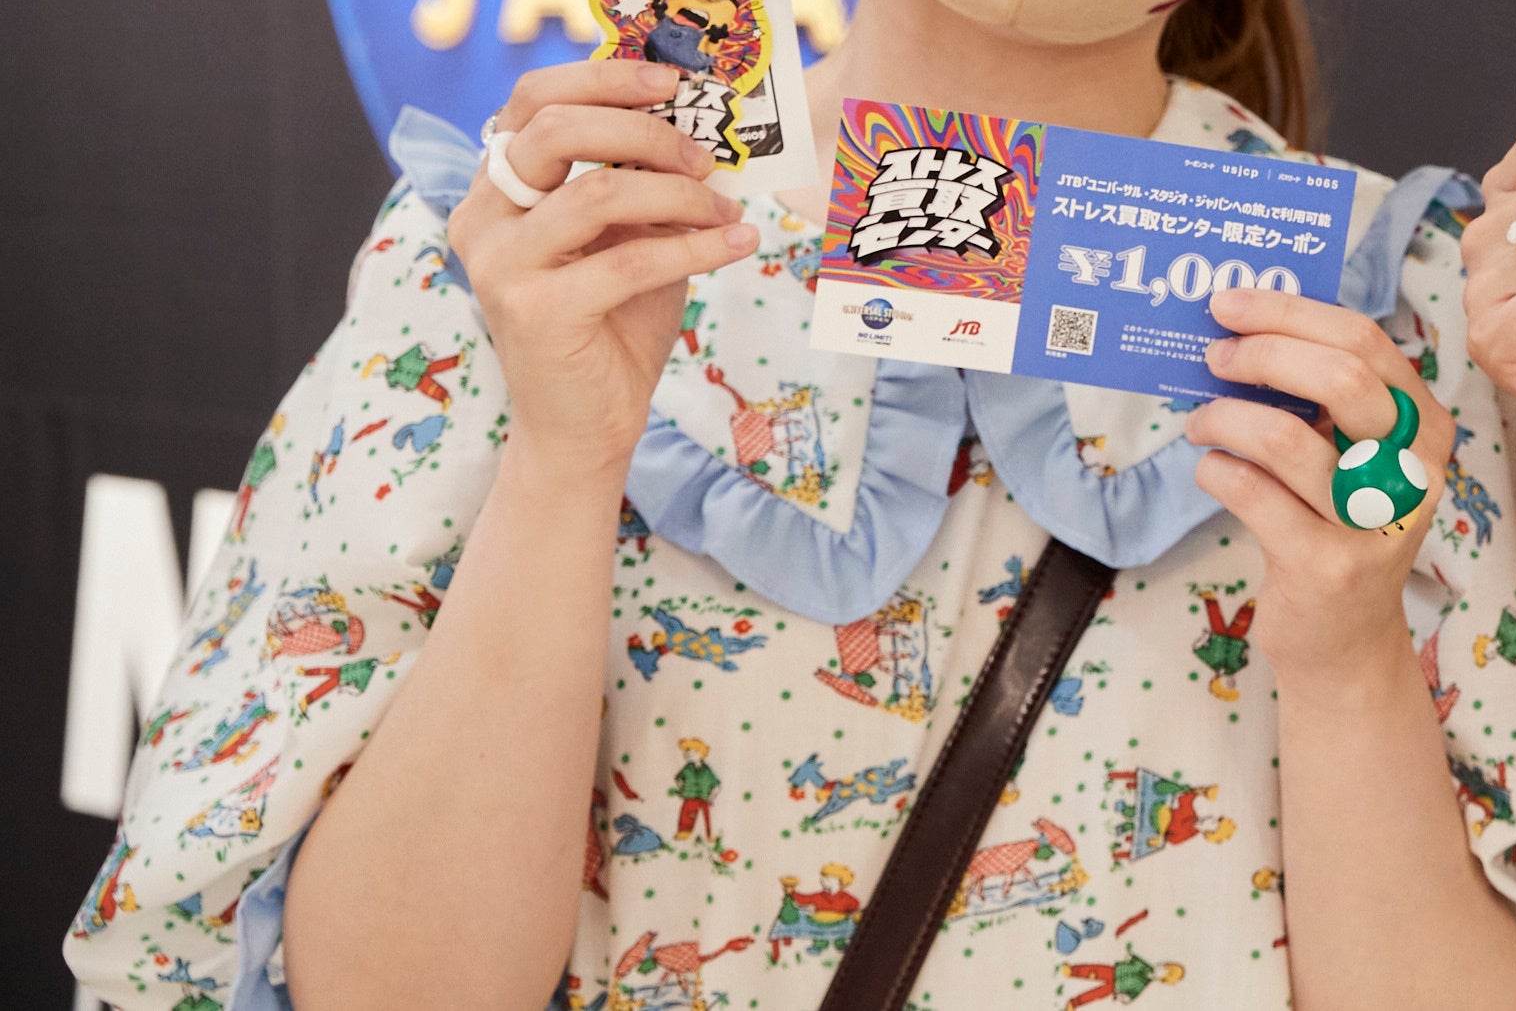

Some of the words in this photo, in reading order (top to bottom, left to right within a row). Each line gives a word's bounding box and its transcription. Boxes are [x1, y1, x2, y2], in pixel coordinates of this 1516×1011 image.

[872, 149, 1008, 196] ストレス
[1222, 163, 1259, 178] usjcp
[855, 179, 998, 229] 買取
[1057, 173, 1332, 228] JTB「ユニバーサル・スタジオ・ジャパンへの旅」で利用可能
[850, 215, 994, 258] センター
[1052, 197, 1327, 255] ストレス買取センター限定クーポン
[950, 319, 981, 335] JTB
